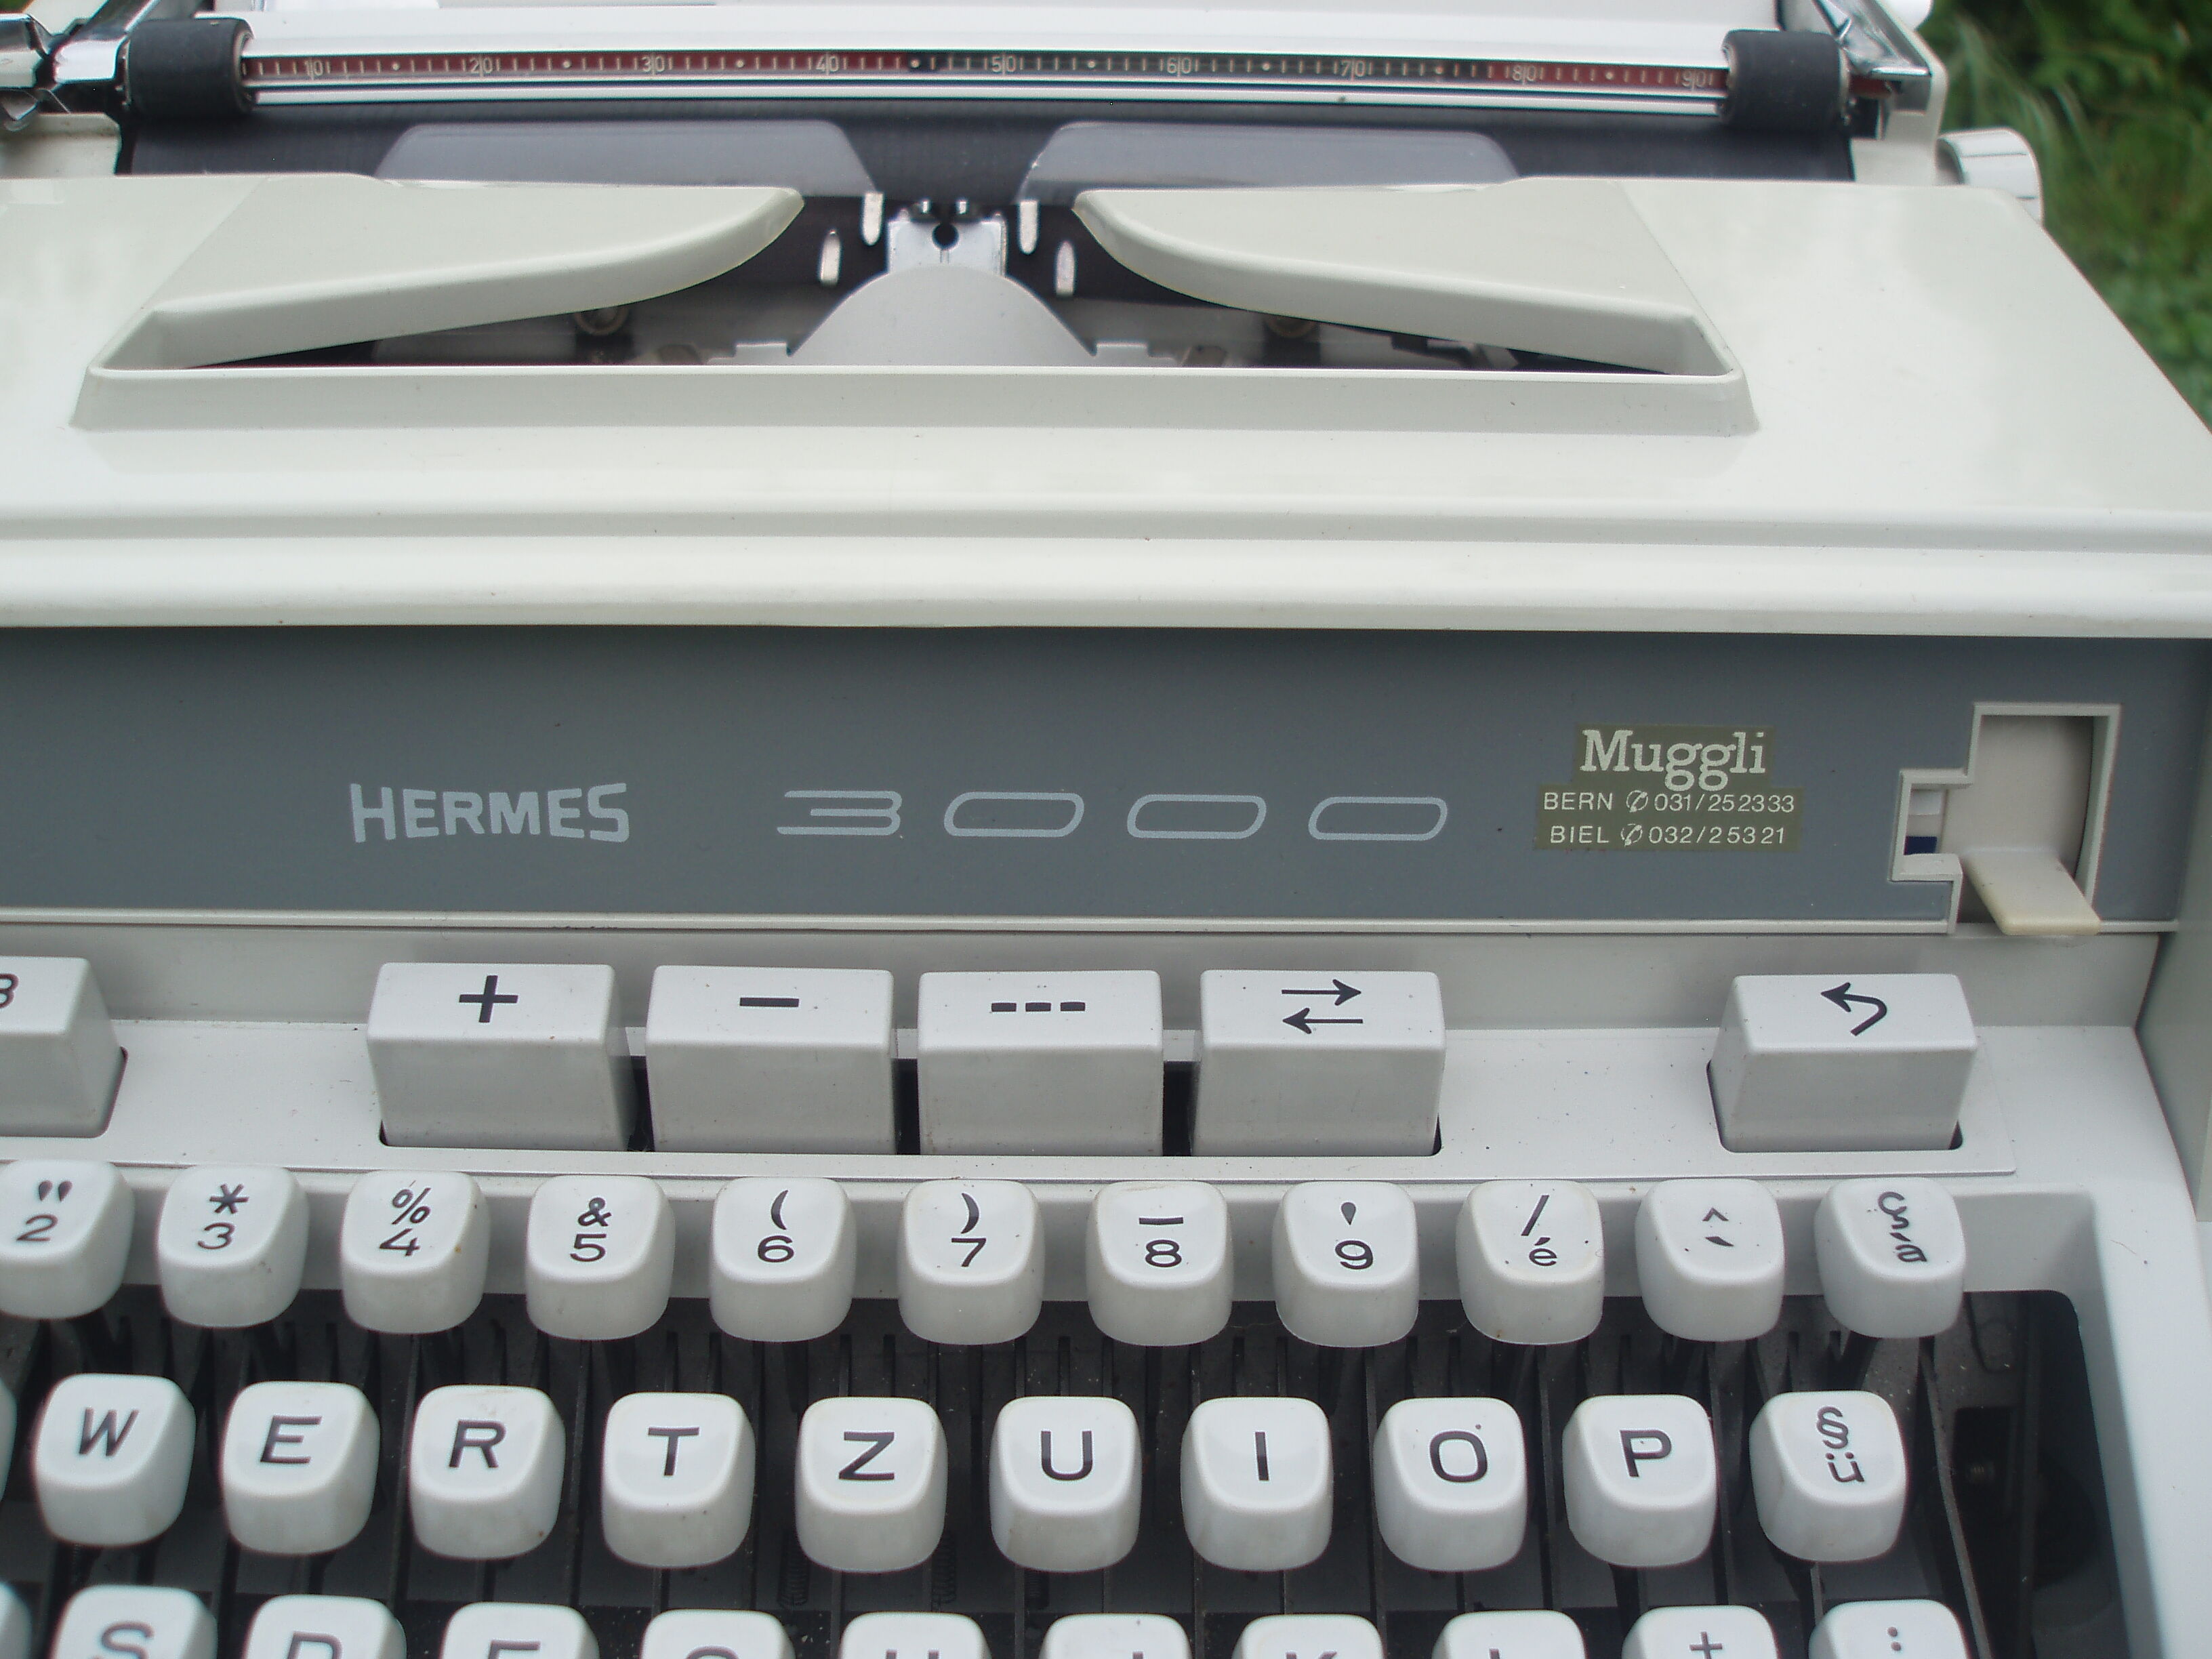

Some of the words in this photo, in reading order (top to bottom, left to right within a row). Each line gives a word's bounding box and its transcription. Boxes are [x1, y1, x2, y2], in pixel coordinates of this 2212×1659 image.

[470, 57, 493, 74] 20
[642, 56, 665, 73] 30
[815, 55, 839, 72] 40
[991, 55, 1016, 73] 50
[1167, 56, 1191, 74] 60
[1341, 59, 1366, 77] 70
[1512, 65, 1537, 82] 80
[1681, 70, 1706, 88] 90
[1580, 729, 1766, 792] Muggli
[350, 782, 630, 843] HERMES
[1544, 792, 1613, 811] BERN
[1550, 825, 1610, 844] BIEL
[577, 1197, 612, 1227] &
[15, 1214, 58, 1243] 2
[197, 1222, 235, 1250] 3
[378, 1228, 420, 1257] 4
[569, 1233, 607, 1263] 5
[757, 1235, 794, 1263] 6
[951, 1237, 987, 1268] 7
[1145, 1239, 1183, 1268] 8
[1334, 1240, 1374, 1270] 9
[1528, 1237, 1557, 1267] é
[78, 1408, 139, 1458] W
[259, 1416, 321, 1465] E
[448, 1420, 506, 1469] R
[647, 1427, 699, 1477] T
[838, 1431, 895, 1482] Z
[1040, 1431, 1093, 1481] U
[1254, 1431, 1269, 1481] I
[1429, 1431, 1488, 1483] O
[1620, 1430, 1672, 1478] P
[1825, 1452, 1865, 1483] ü
[93, 1621, 154, 1659] S
